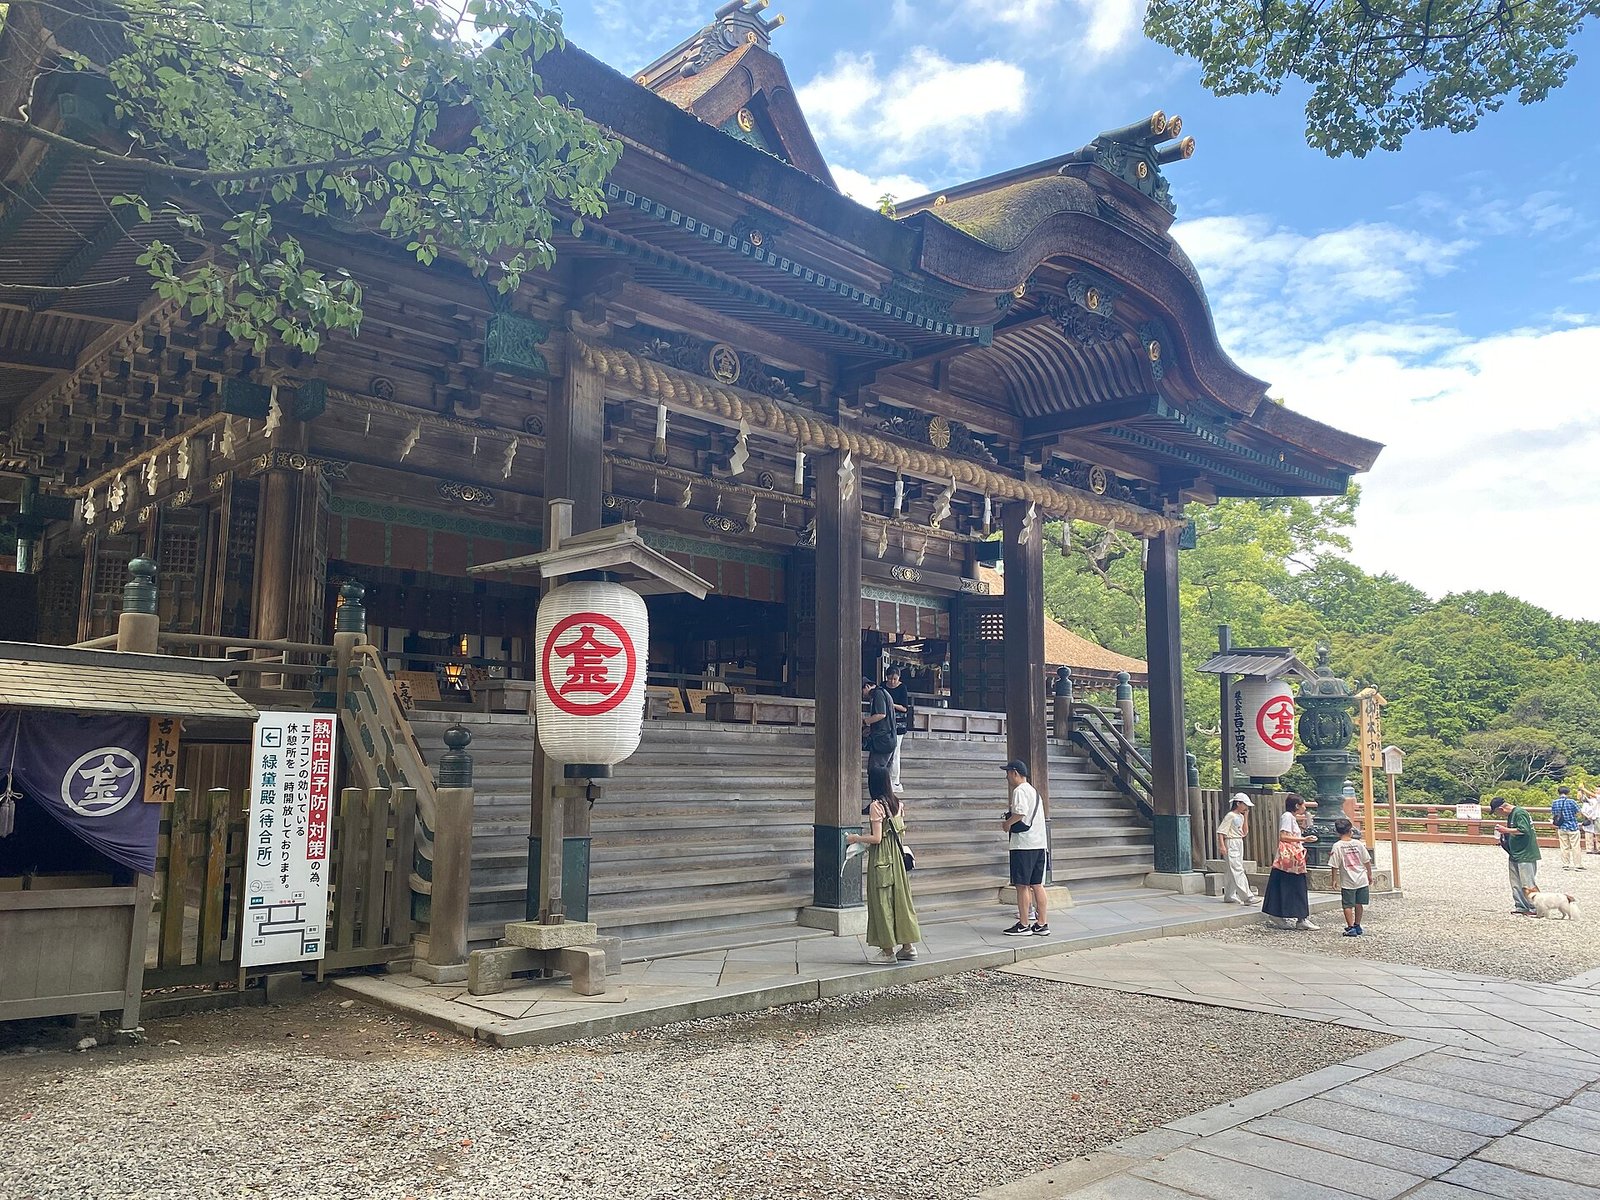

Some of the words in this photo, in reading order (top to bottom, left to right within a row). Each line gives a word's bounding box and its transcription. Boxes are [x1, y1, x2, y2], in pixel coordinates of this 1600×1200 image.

[149, 718, 176, 801] 古札納所
[279, 722, 298, 889] 休憩所を一時開放しております。
[296, 724, 311, 837] エアコンの効いている
